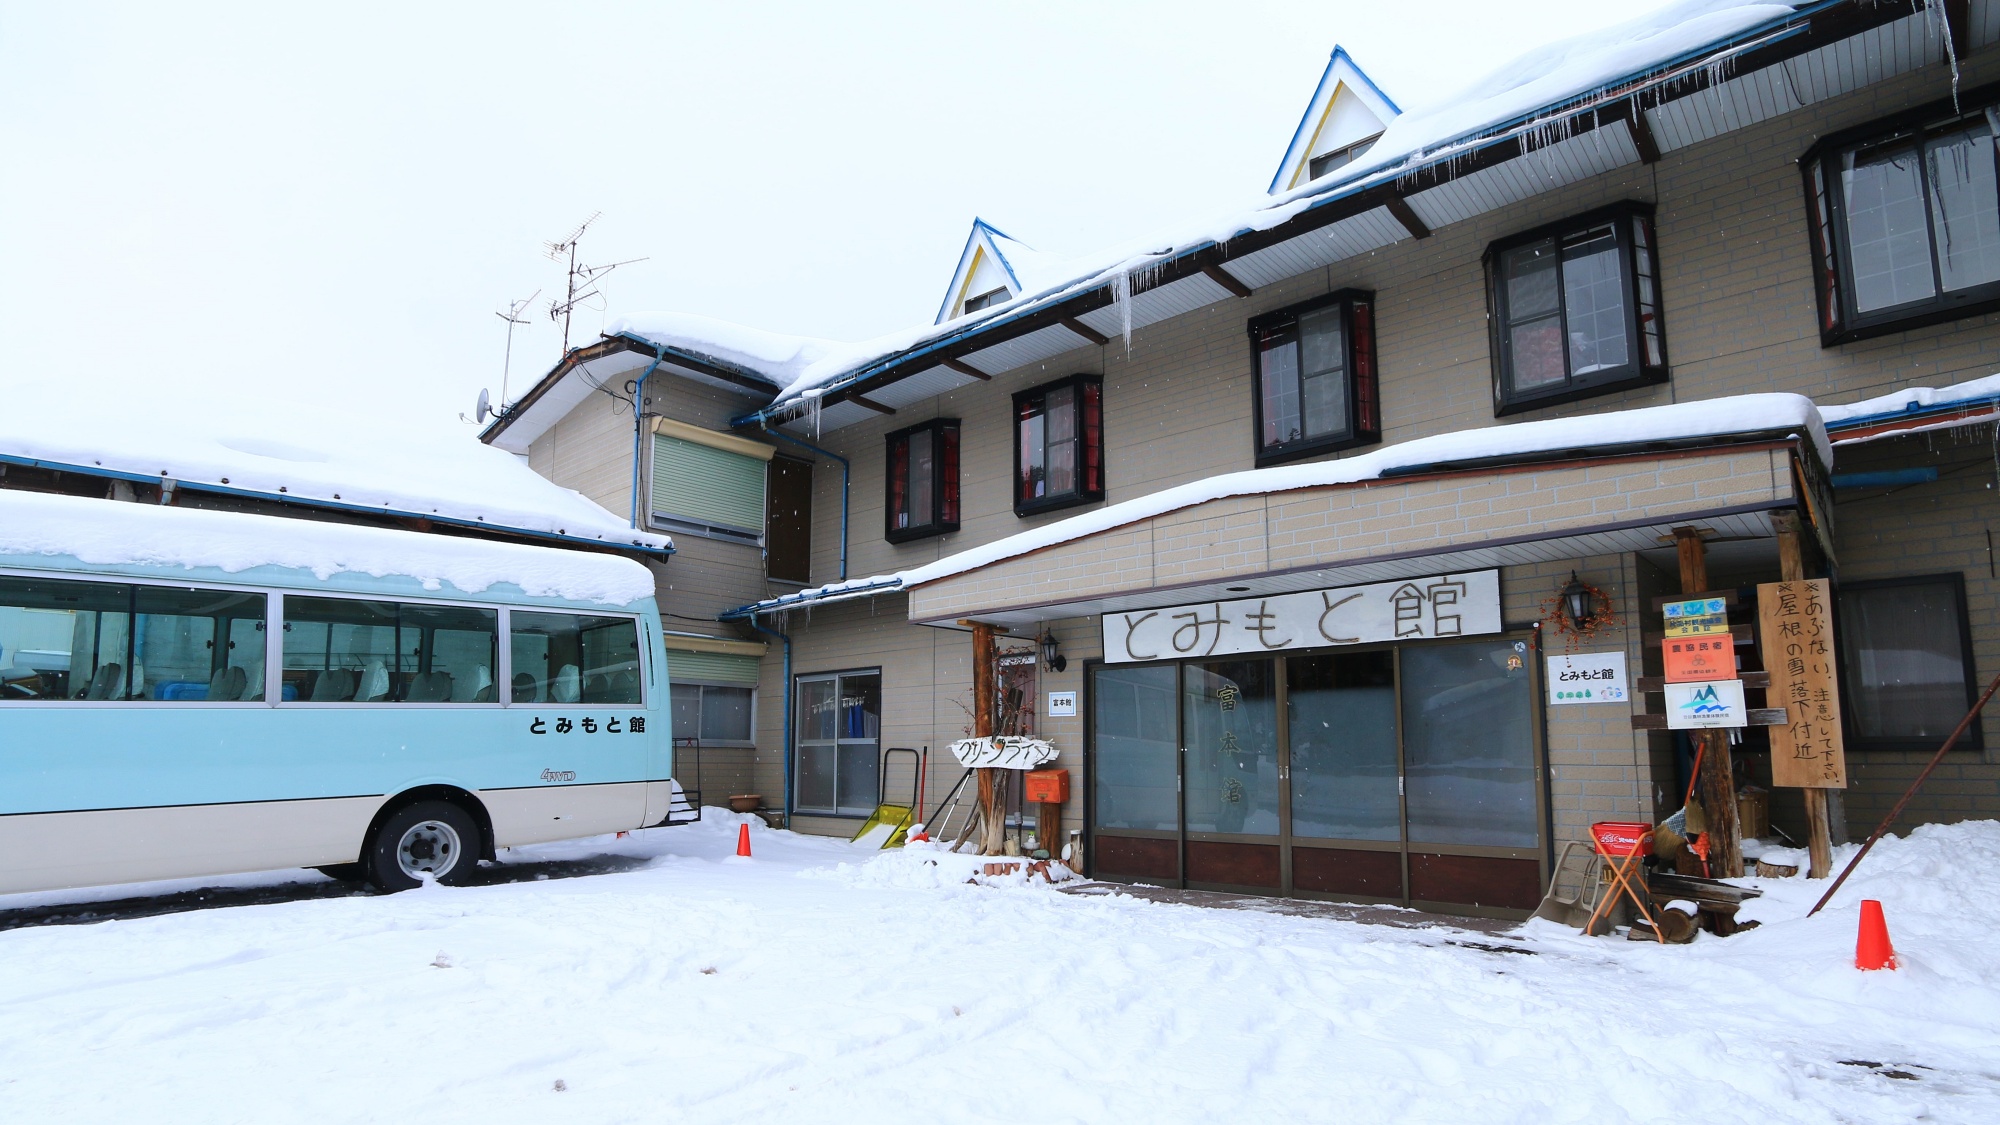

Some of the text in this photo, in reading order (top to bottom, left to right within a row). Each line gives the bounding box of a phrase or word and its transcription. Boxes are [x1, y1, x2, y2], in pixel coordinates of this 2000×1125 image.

[1124, 577, 1466, 660] とみもと館
[1559, 668, 1614, 681] とみもと館
[529, 716, 646, 734] とみもと館
[1216, 683, 1243, 804] 富本館
[540, 768, 576, 782] 4WD
